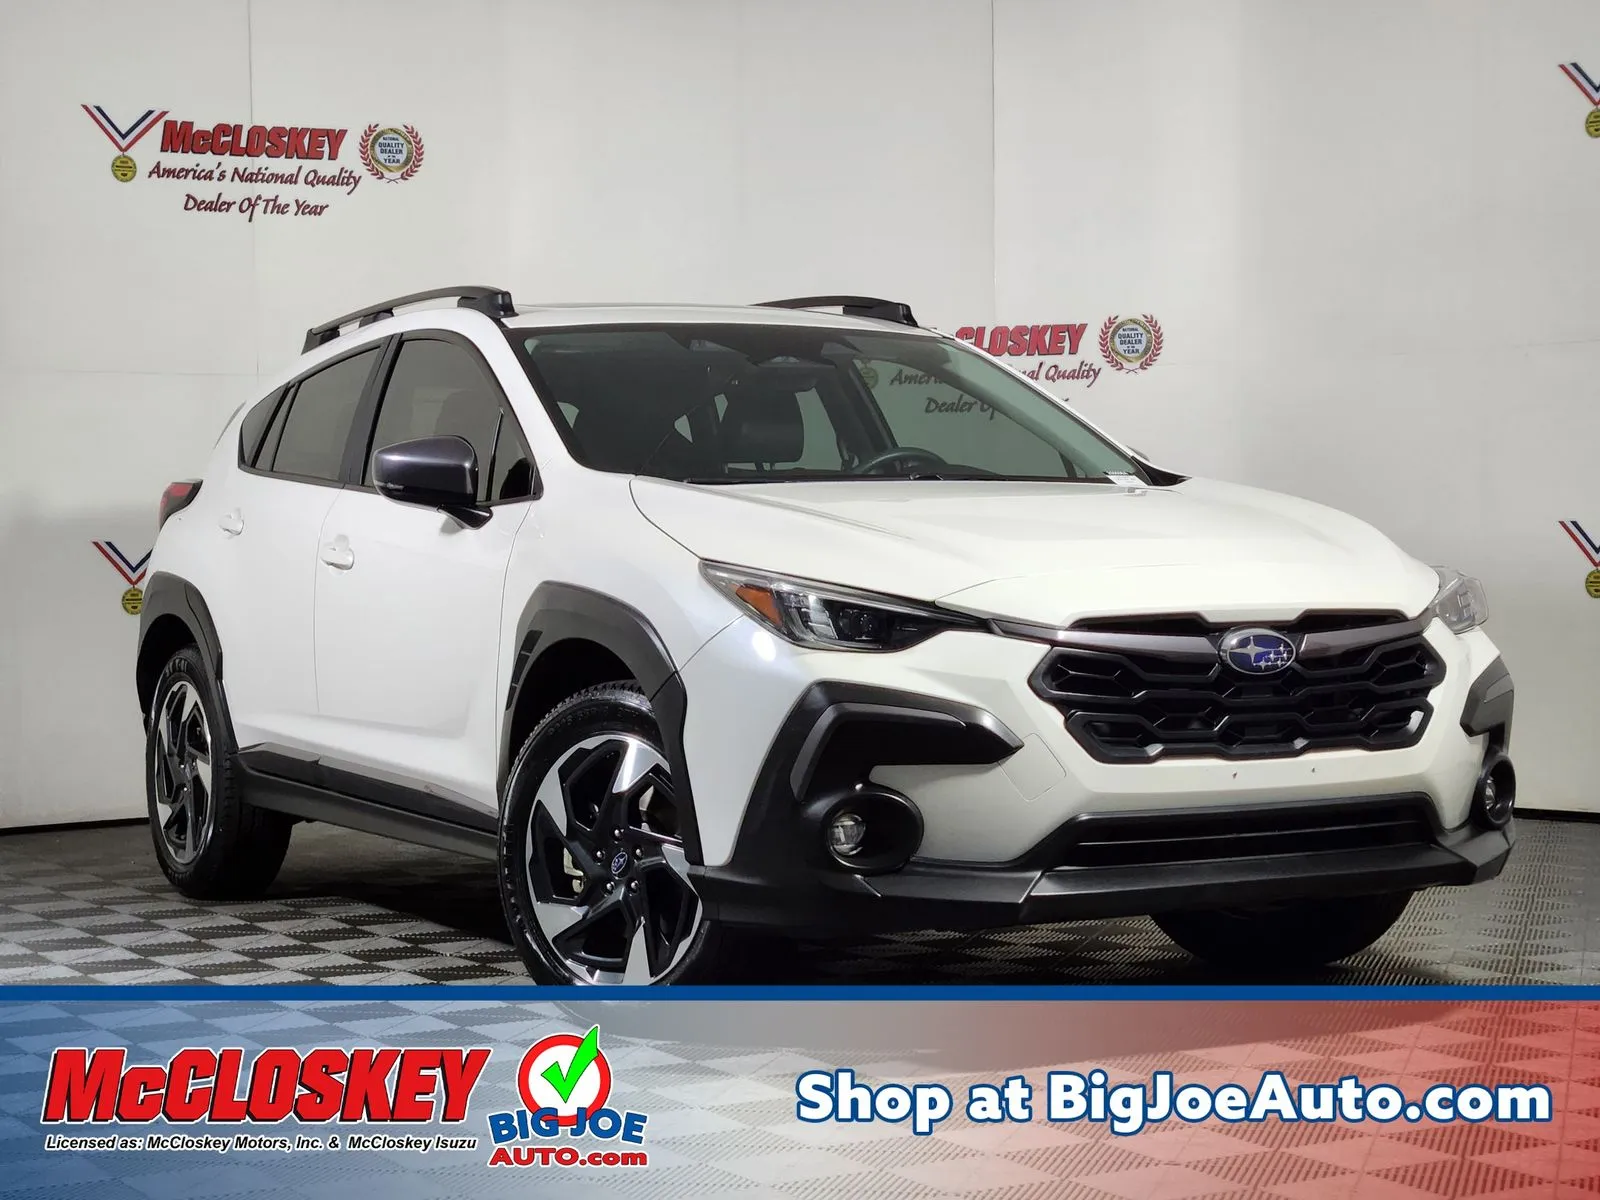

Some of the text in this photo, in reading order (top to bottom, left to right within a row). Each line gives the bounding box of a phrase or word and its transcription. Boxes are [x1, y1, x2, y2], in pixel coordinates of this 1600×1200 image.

[160, 119, 348, 160] McCLOSKEY
[147, 161, 226, 181] America's
[230, 165, 303, 185] National
[304, 166, 362, 196] Quality
[183, 192, 330, 223] Dealer Of The Year
[1117, 332, 1143, 340] QUALITY
[1044, 360, 1102, 388] Quality
[924, 394, 978, 414] Dealer
